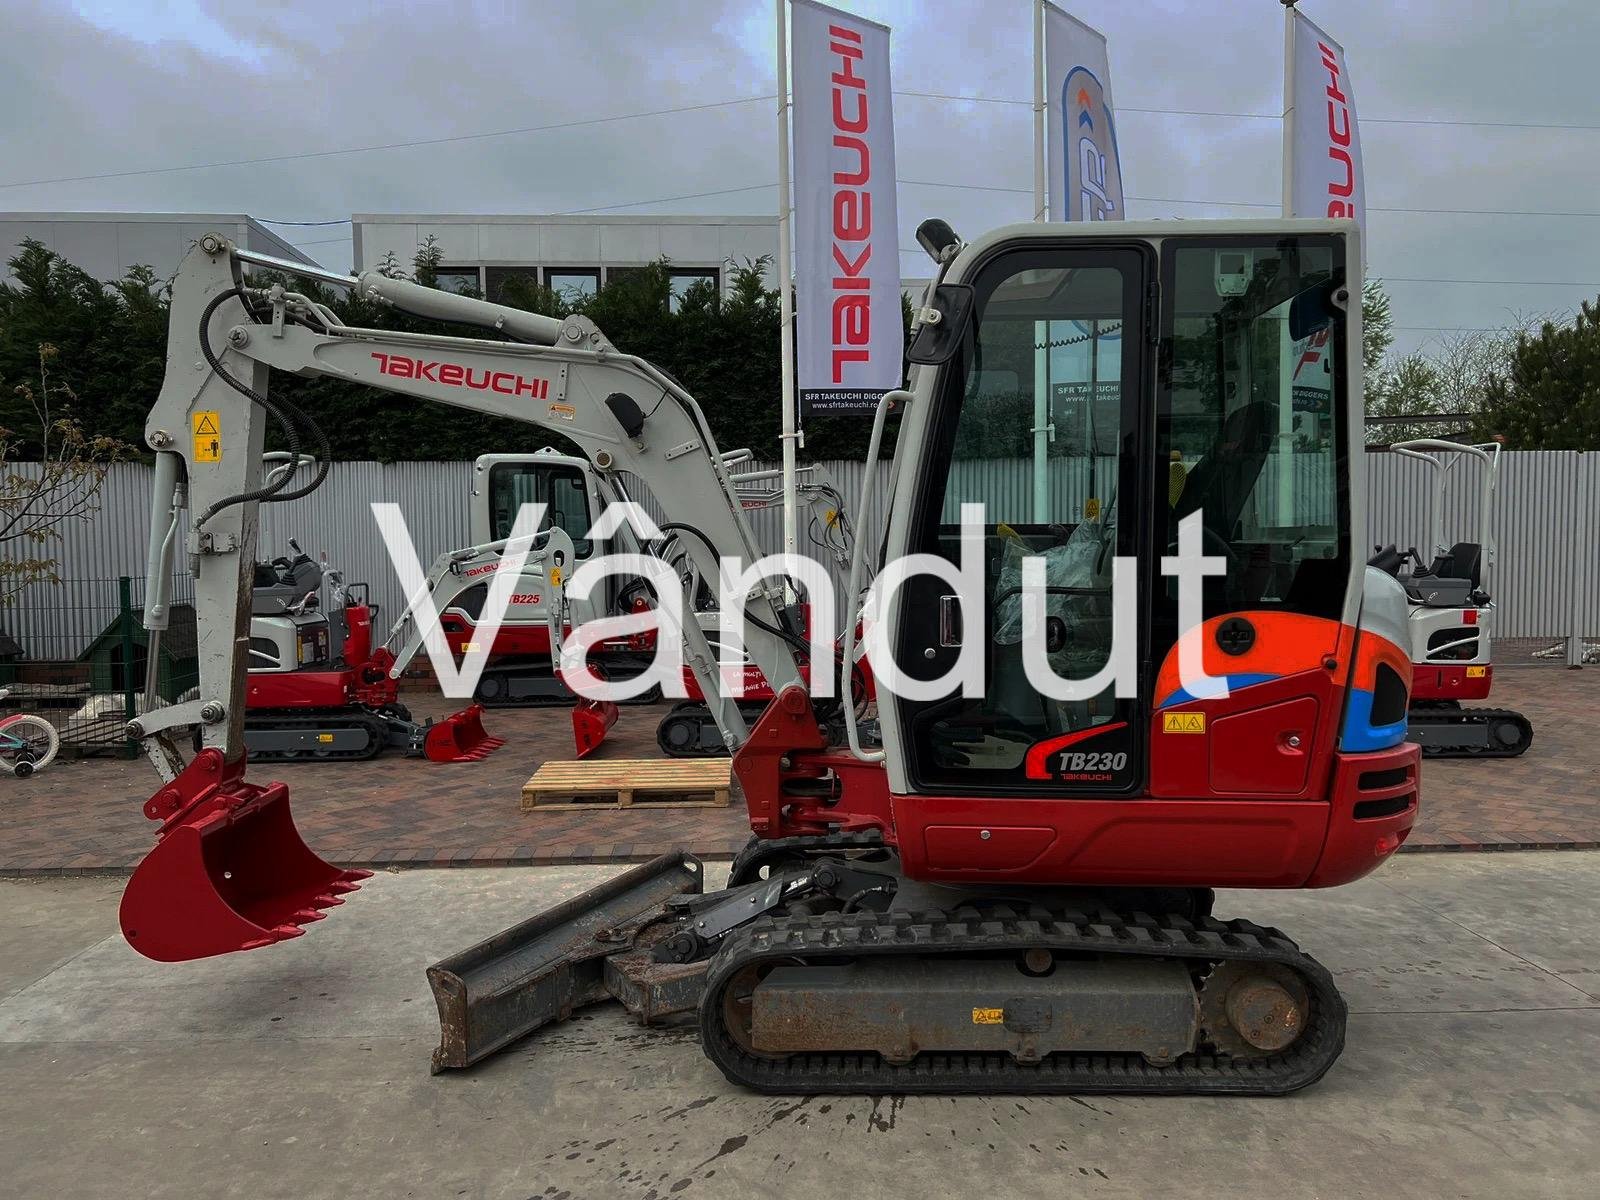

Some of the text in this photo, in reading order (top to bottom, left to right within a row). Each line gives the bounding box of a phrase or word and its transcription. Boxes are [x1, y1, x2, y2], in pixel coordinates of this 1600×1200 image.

[829, 24, 872, 383] TAKEUCHI
[371, 352, 549, 399] TAKEUCHI
[821, 392, 862, 401] TAKEUCHI
[863, 392, 884, 400] DIGG
[1060, 752, 1128, 771] TB230
